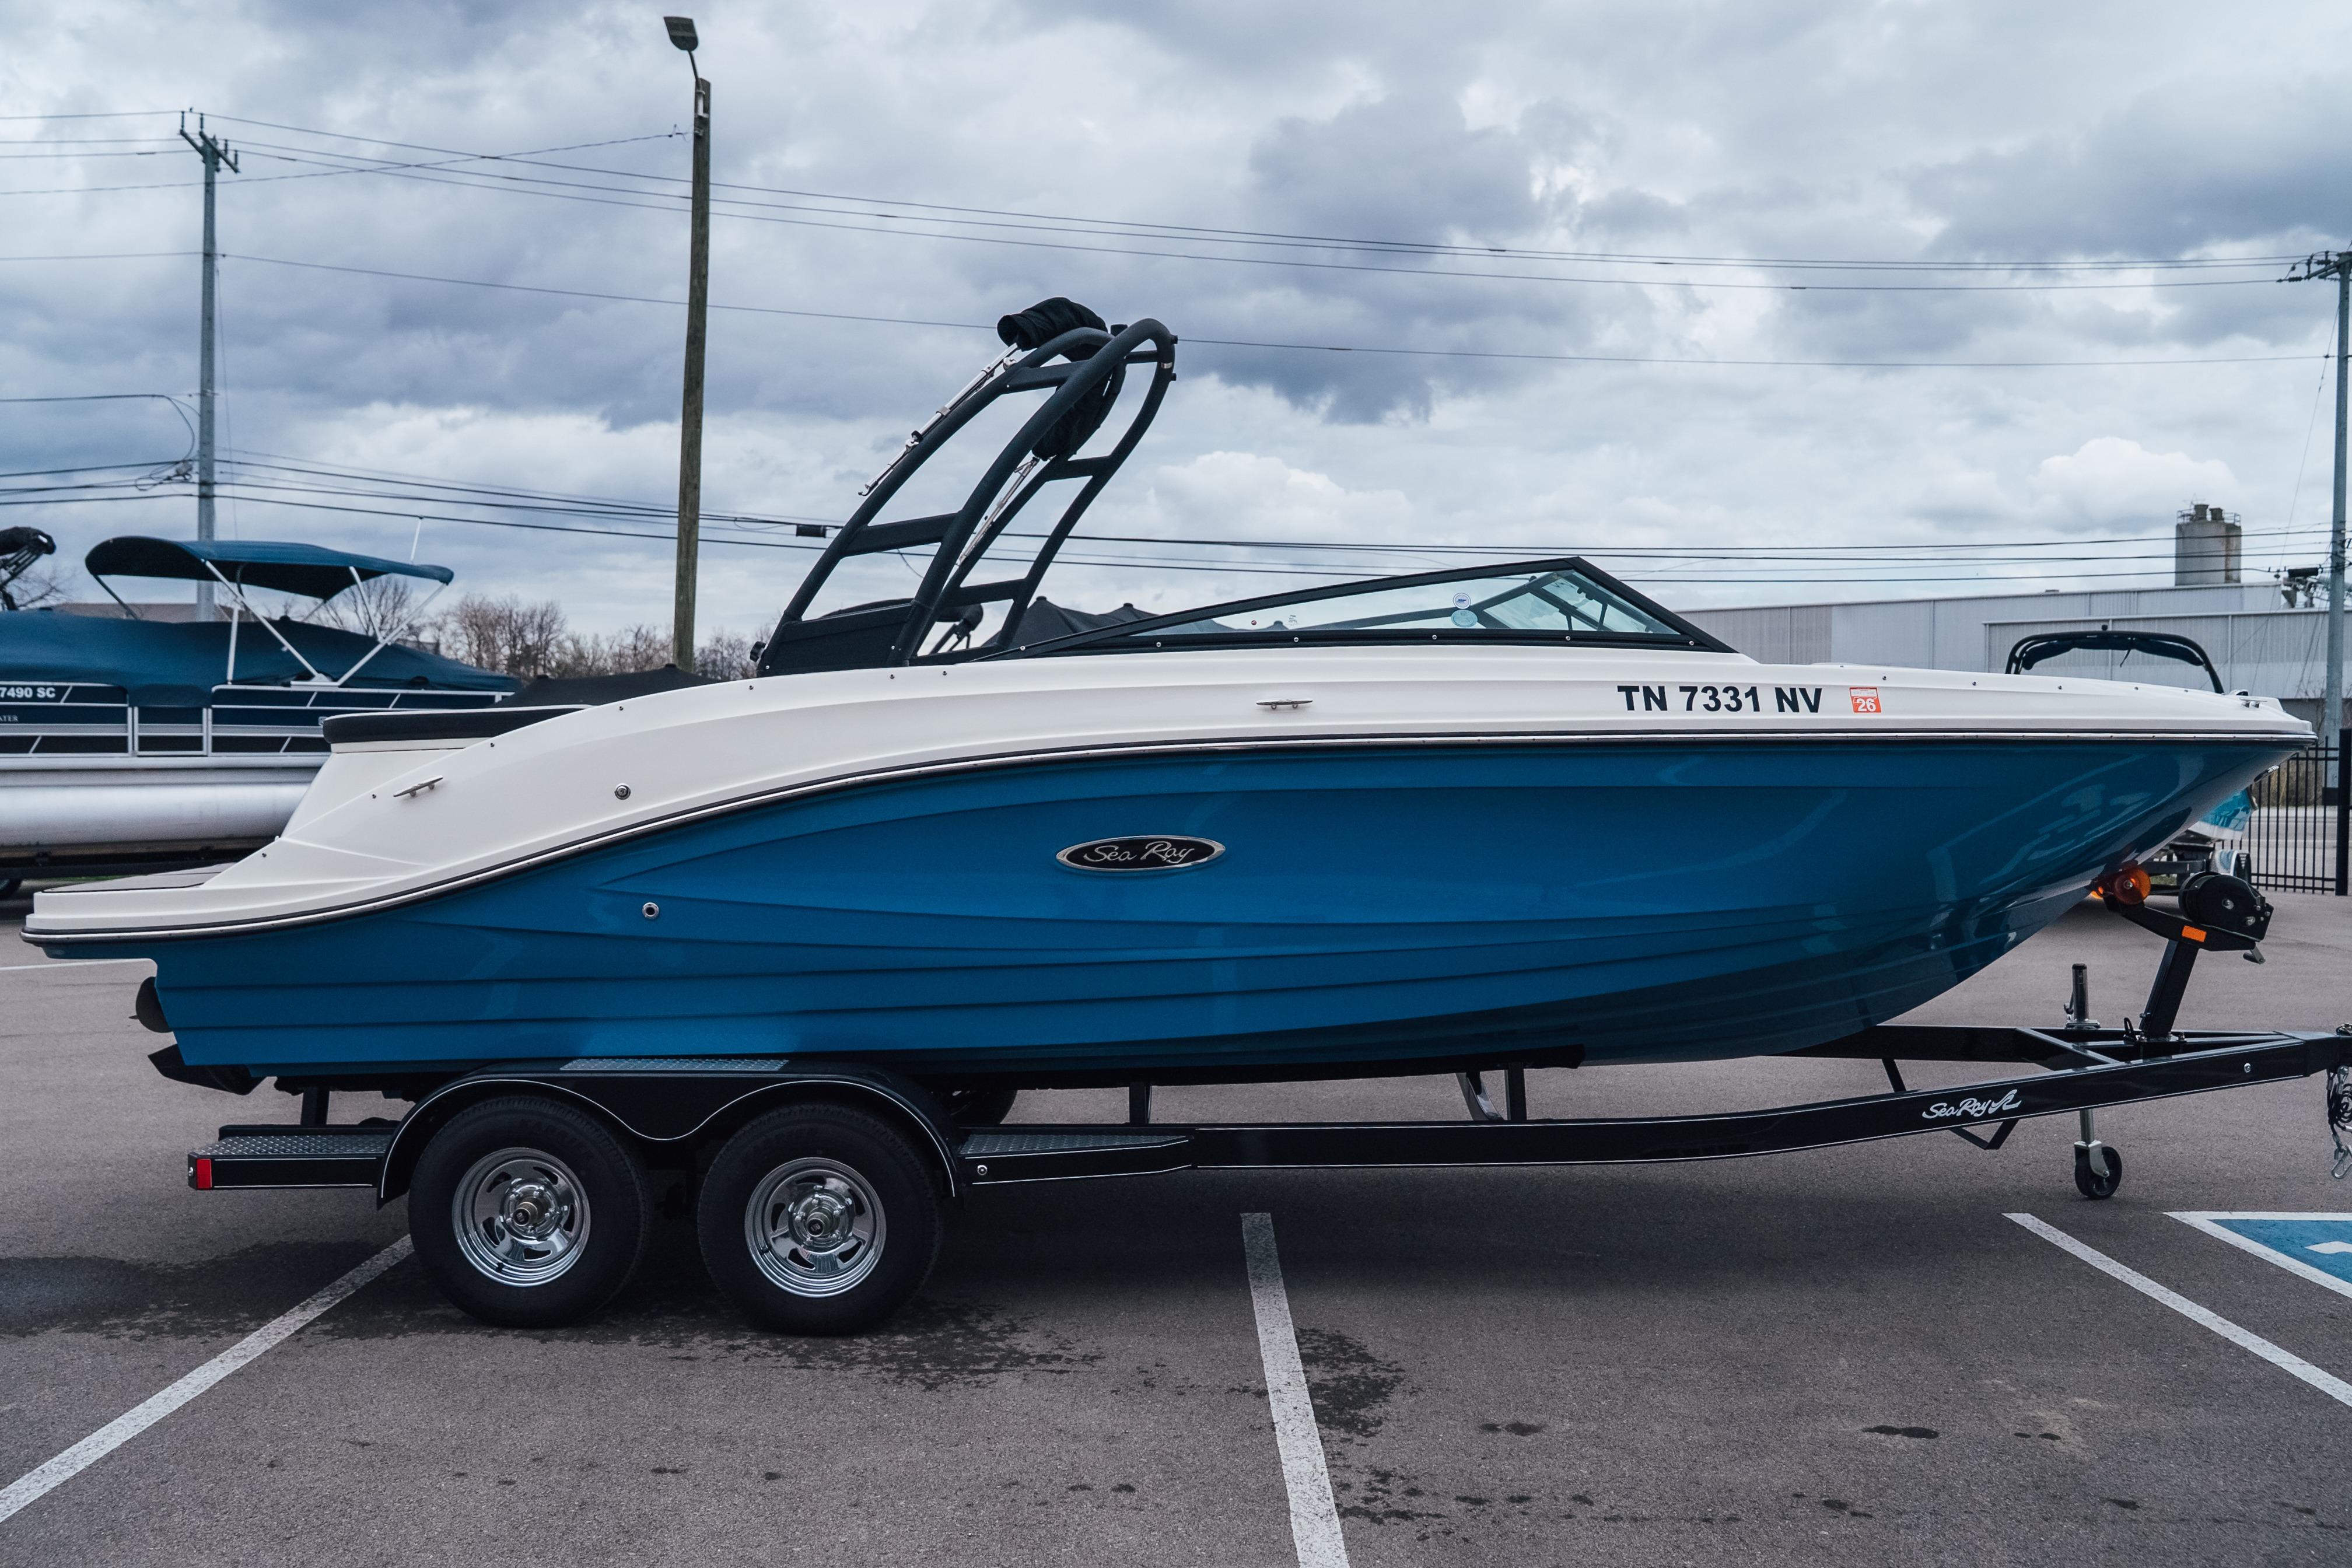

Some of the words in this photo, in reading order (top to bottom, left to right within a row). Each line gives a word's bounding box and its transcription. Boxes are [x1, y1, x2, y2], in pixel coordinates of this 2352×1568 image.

[0, 687, 33, 698] 7490
[36, 687, 55, 698] SC
[1617, 685, 1668, 711] TN
[1679, 685, 1760, 712] 7331
[1775, 687, 1822, 713] NV
[1856, 698, 1877, 712] 26
[1083, 845, 1137, 862] Sea
[1140, 841, 1195, 863] Ray
[1922, 1102, 1959, 1118] Sea
[1956, 1098, 1992, 1117] Ray
